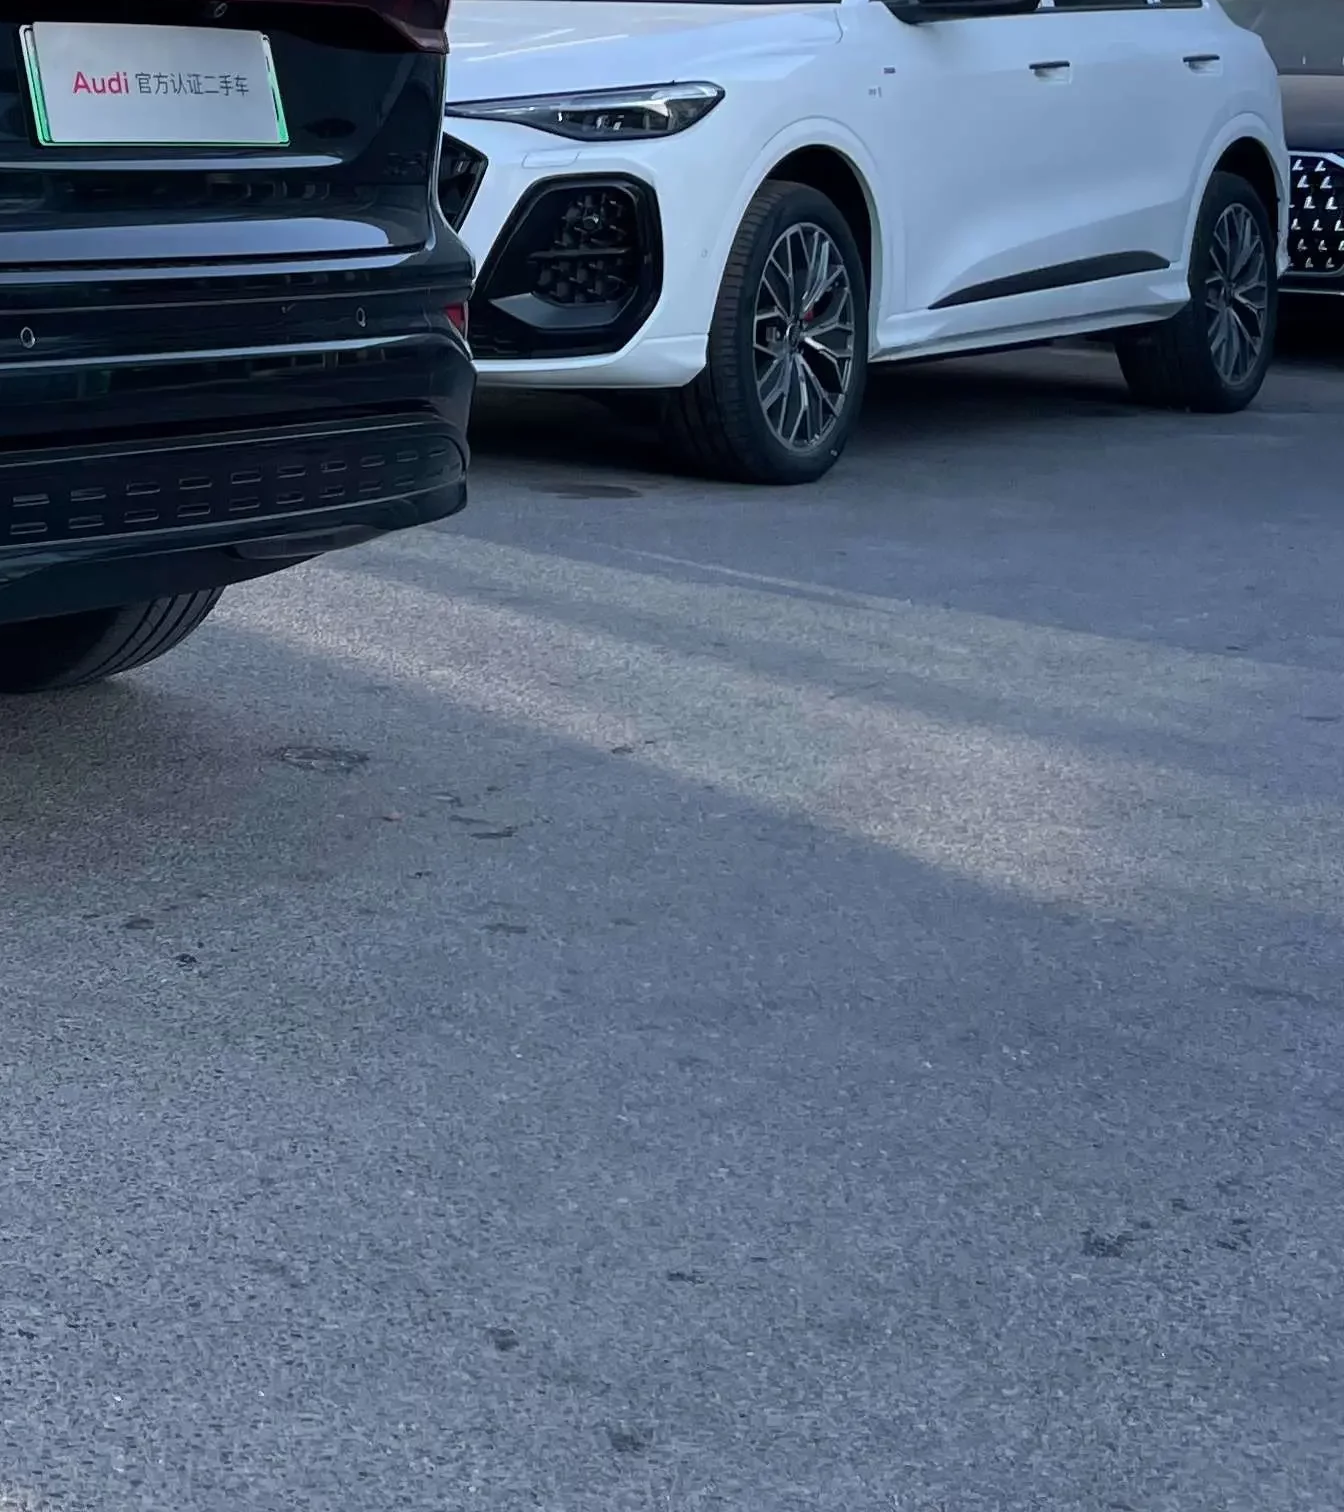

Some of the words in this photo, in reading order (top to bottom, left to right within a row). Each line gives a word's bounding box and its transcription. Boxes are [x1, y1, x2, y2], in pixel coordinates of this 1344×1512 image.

[72, 71, 129, 94] Audi
[135, 72, 249, 98] 官方认证二手车
